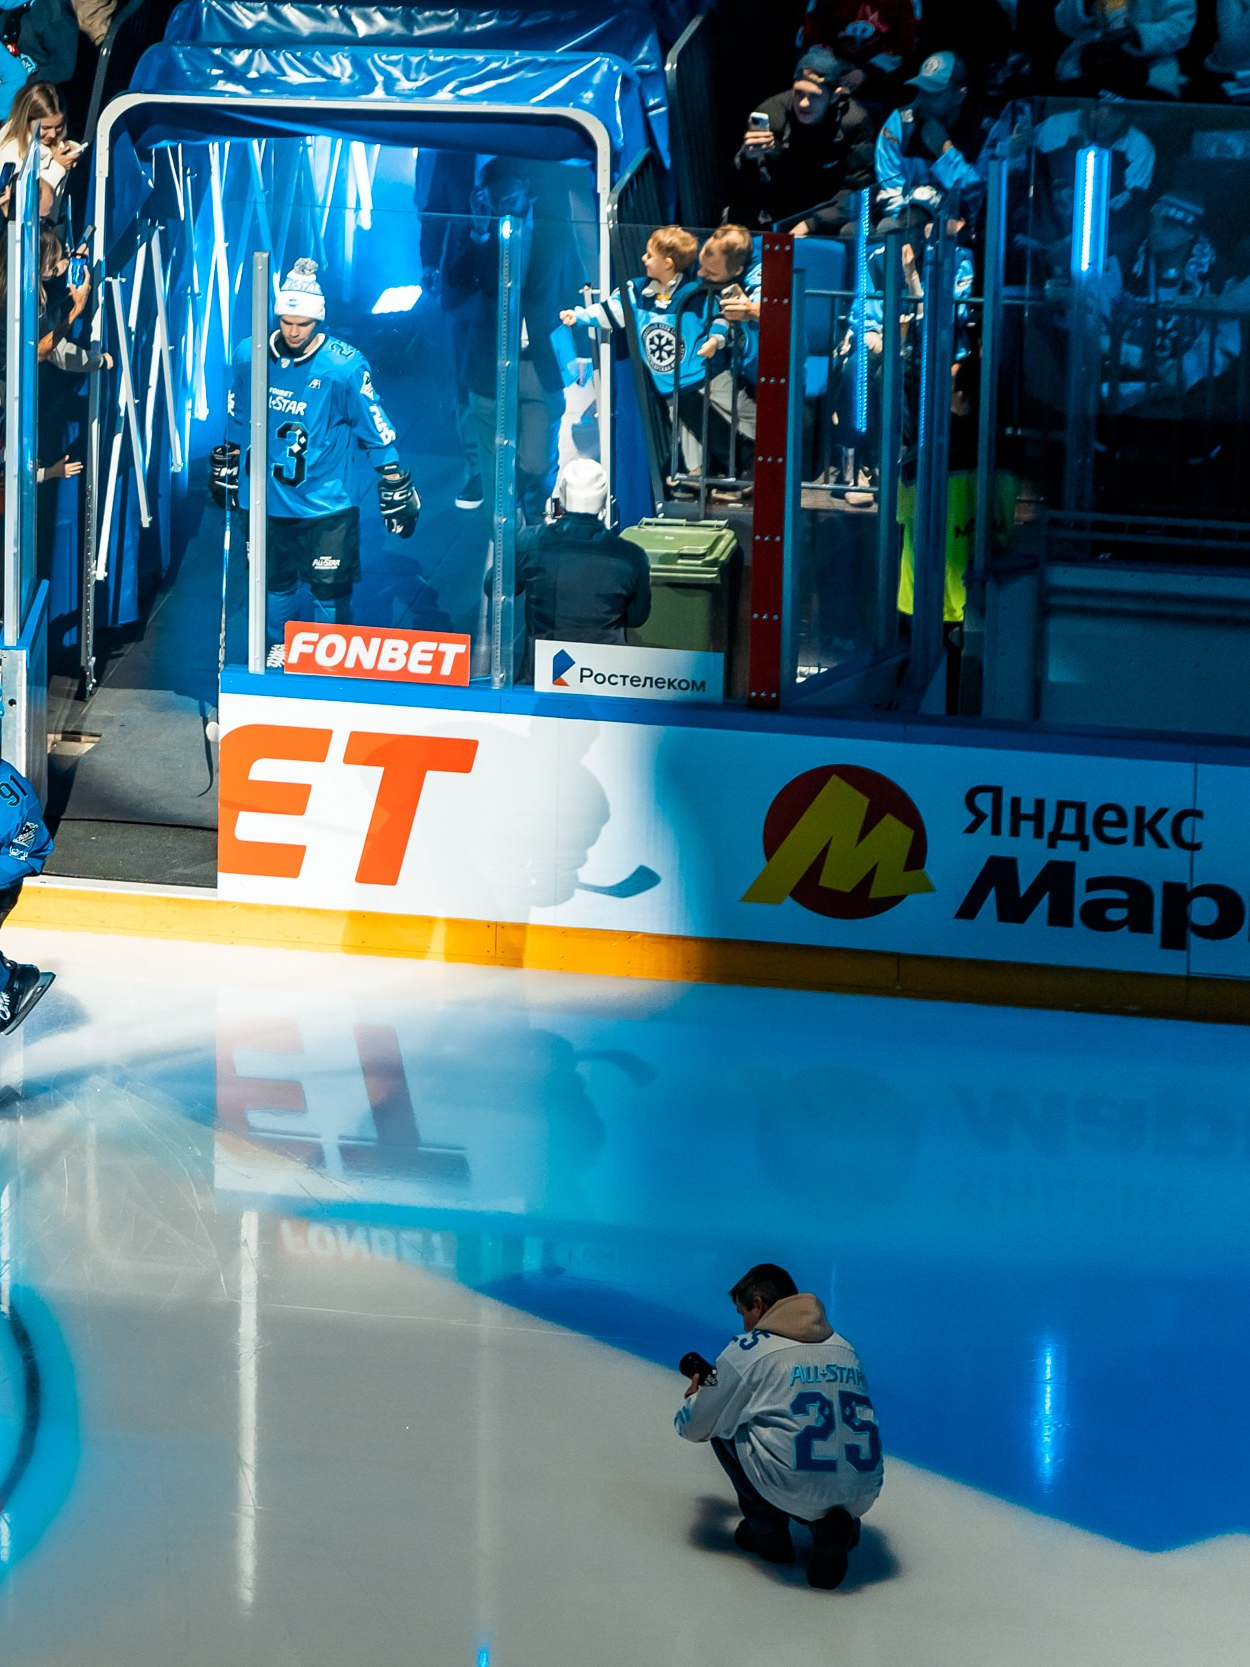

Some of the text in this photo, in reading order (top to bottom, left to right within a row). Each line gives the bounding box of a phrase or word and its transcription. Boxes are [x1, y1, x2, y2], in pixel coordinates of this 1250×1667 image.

[287, 632, 467, 676] FONBET
[579, 667, 707, 693] Ростелеком
[962, 784, 1205, 852] Яндекс
[953, 855, 1250, 951] Мар
[790, 1390, 883, 1473] 25
